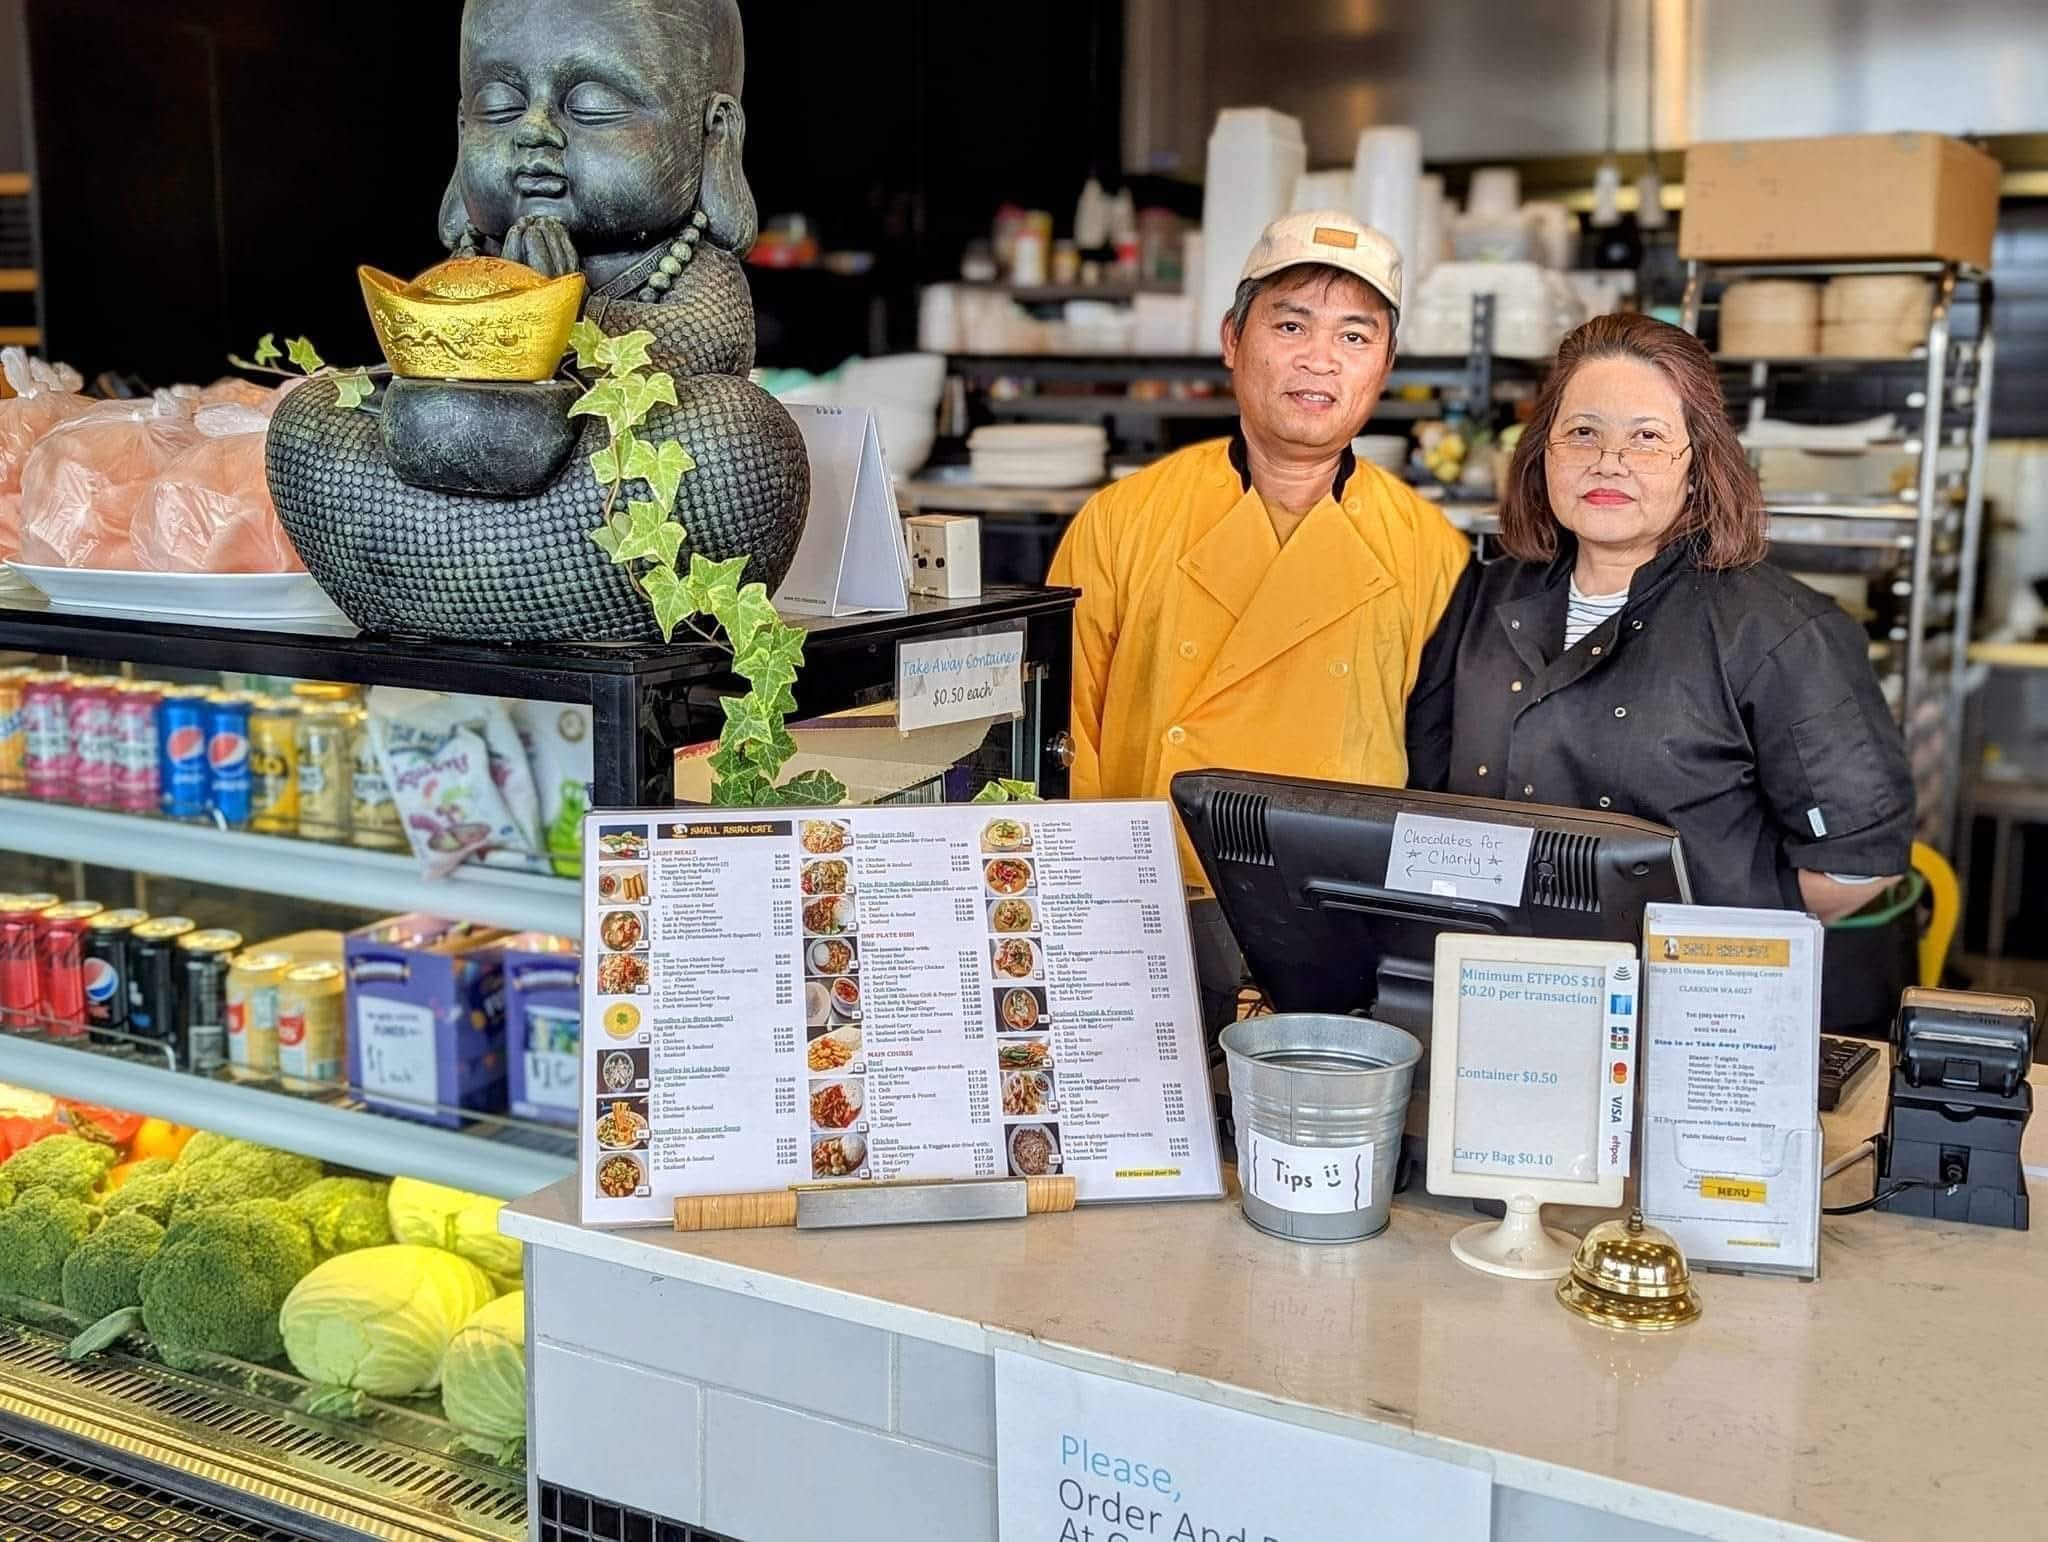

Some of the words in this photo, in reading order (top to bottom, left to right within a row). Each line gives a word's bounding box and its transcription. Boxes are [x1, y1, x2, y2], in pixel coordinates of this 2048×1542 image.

[903, 658, 929, 676] Take
[932, 657, 963, 675] Away
[966, 651, 1020, 669] Container
[932, 686, 964, 708] $0.50
[967, 681, 993, 701] each
[690, 826, 720, 835] SMALL
[723, 825, 749, 834] ASIAN
[1403, 828, 1472, 848] Chocolates
[1481, 834, 1504, 848] for
[1428, 850, 1481, 875] Charity
[1462, 968, 1523, 983] Minimum
[1527, 972, 1578, 986] ETFPOS
[1581, 975, 1606, 988] $10
[1725, 969, 1758, 978] Shopping
[1461, 984, 1496, 998] $0.20
[1499, 989, 1521, 1001] per
[1524, 990, 1598, 1005] transaction
[1680, 985, 1718, 993] CLARKSON
[1719, 1041, 1740, 1050] Away
[1742, 1043, 1776, 1051] (Pickup)
[1456, 1066, 1522, 1082] Container
[1522, 1071, 1558, 1084] $0.50
[1611, 1096, 1623, 1123] VISA
[872, 1138, 899, 1146] Chicken
[1609, 1135, 1619, 1165] eftpos
[1455, 1148, 1489, 1163] Carry
[1492, 1151, 1515, 1165] Bag
[1517, 1152, 1553, 1166] $0.10
[1272, 1158, 1313, 1192] Tips
[1717, 1187, 1751, 1198] MENU
[1062, 1434, 1181, 1503] Please,
[1059, 1478, 1162, 1535] Order
[1059, 1517, 1095, 1542] At
